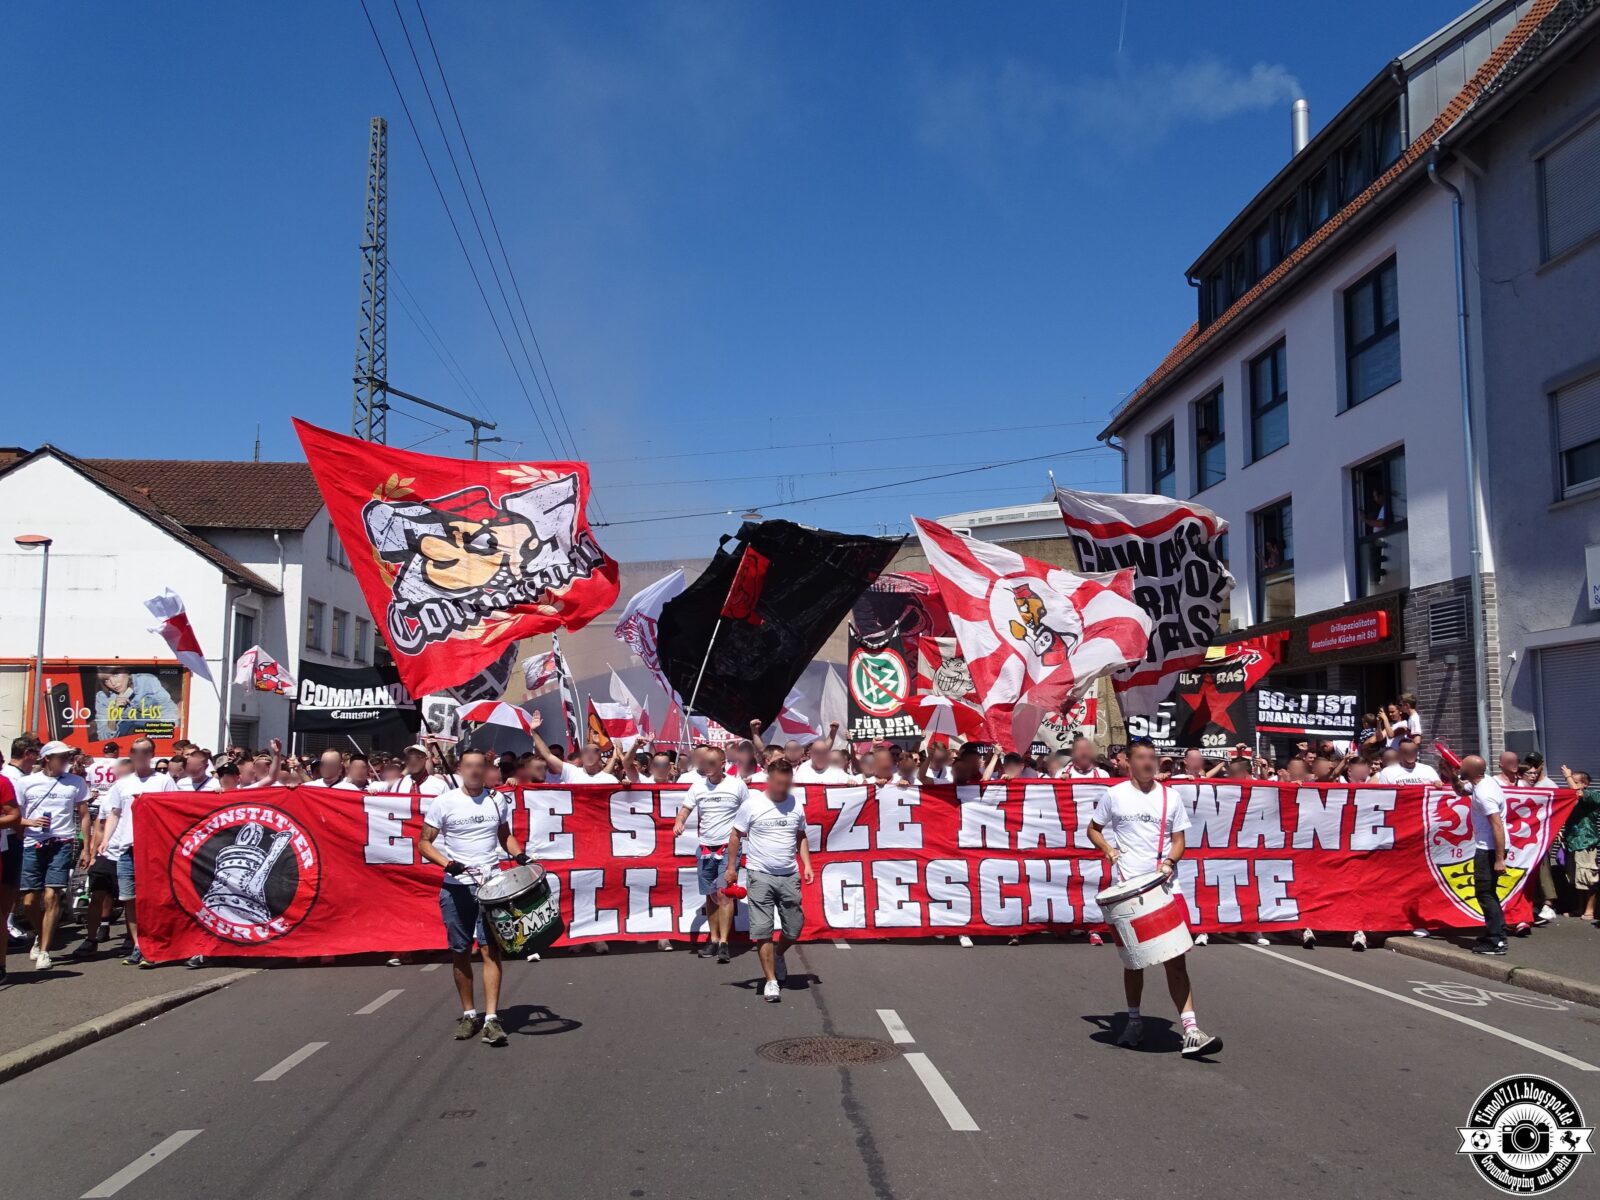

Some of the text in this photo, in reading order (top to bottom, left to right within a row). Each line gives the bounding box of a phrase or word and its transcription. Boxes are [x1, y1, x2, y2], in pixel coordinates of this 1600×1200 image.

[62, 701, 91, 723] glo
[107, 699, 161, 720] for a kiss
[1317, 694, 1357, 714] IST
[855, 716, 881, 728] FÜR
[1258, 711, 1355, 727] UNANTASTBAR!
[95, 766, 116, 784] 56
[1450, 848, 1463, 858] 18
